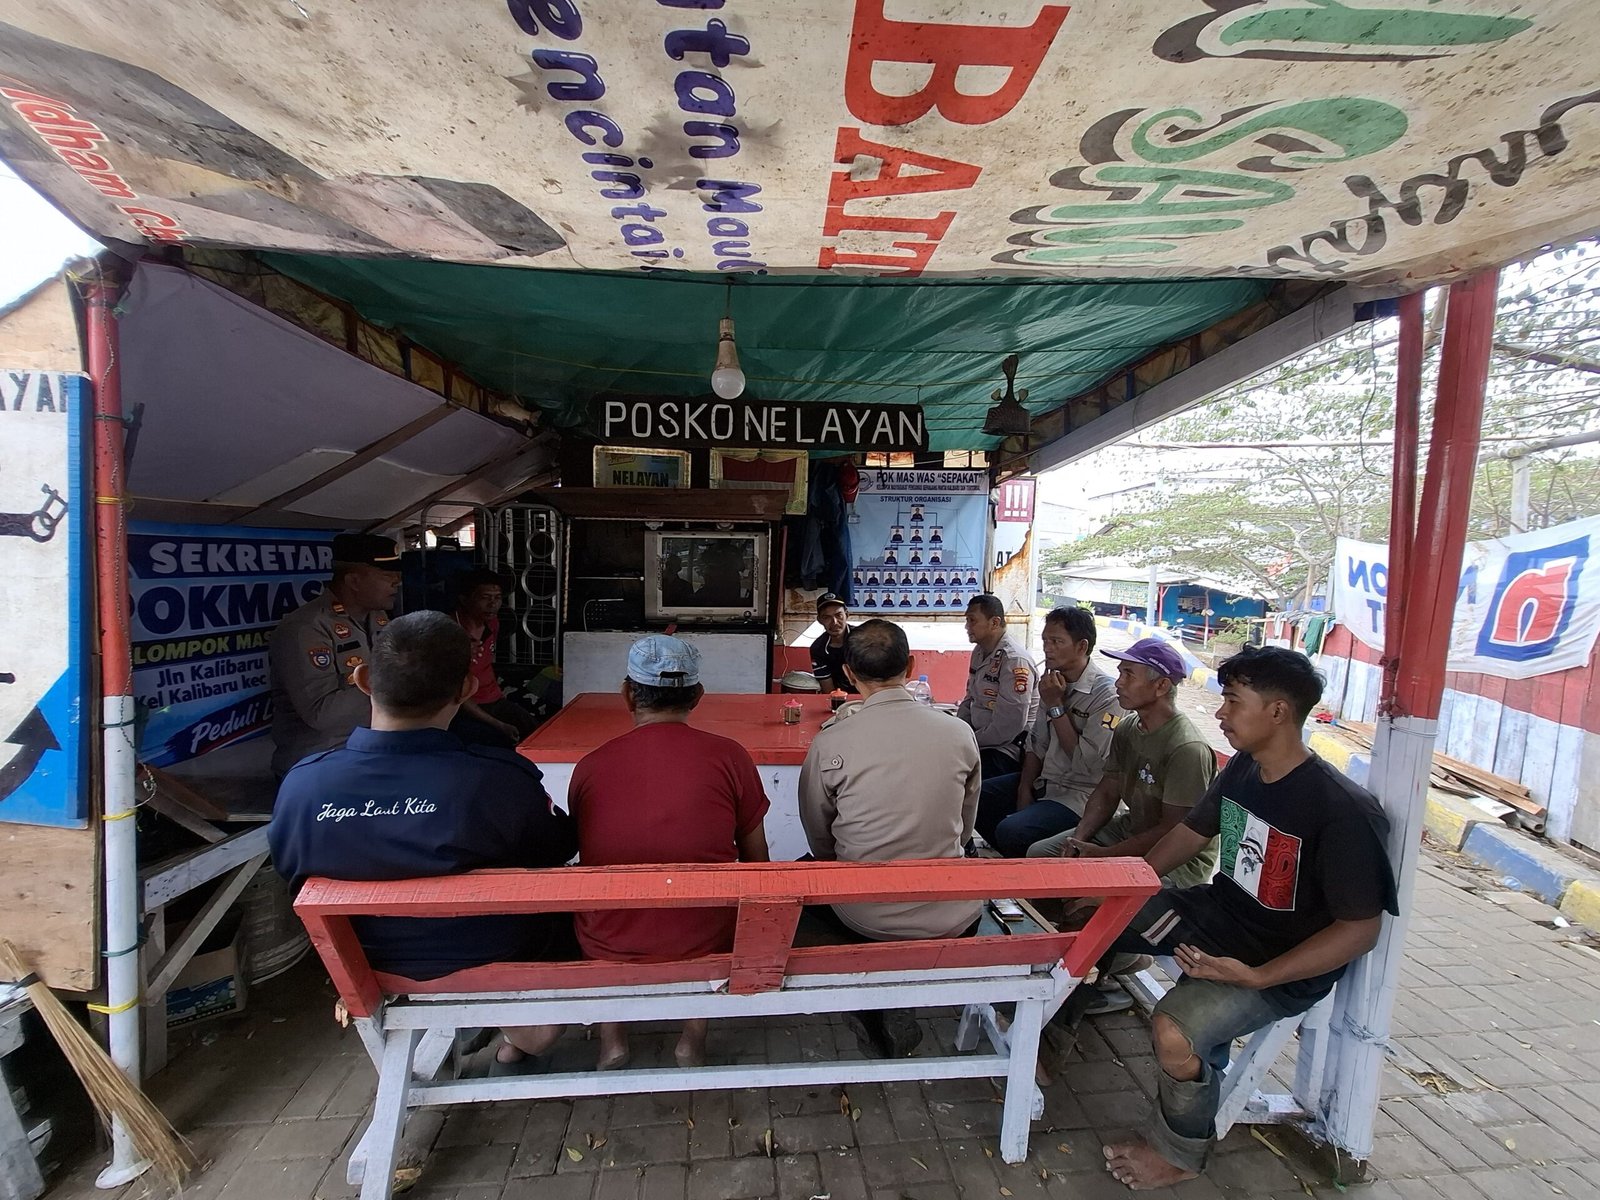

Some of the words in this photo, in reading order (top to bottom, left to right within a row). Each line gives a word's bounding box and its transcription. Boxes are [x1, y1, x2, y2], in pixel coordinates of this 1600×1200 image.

[604, 401, 734, 441] POSKO
[743, 406, 924, 447] NELAYAN
[612, 470, 669, 487] NELAYAN
[896, 472, 915, 484] MAS
[916, 472, 935, 484] WAS
[157, 667, 185, 688] Jln
[191, 657, 264, 681] Kalibaru
[170, 681, 239, 705] Kalibaru
[241, 672, 267, 692] kec
[189, 701, 260, 754] Peduli
[316, 802, 357, 823] Jaga
[360, 799, 400, 818] Laut
[403, 797, 437, 815] Kita
